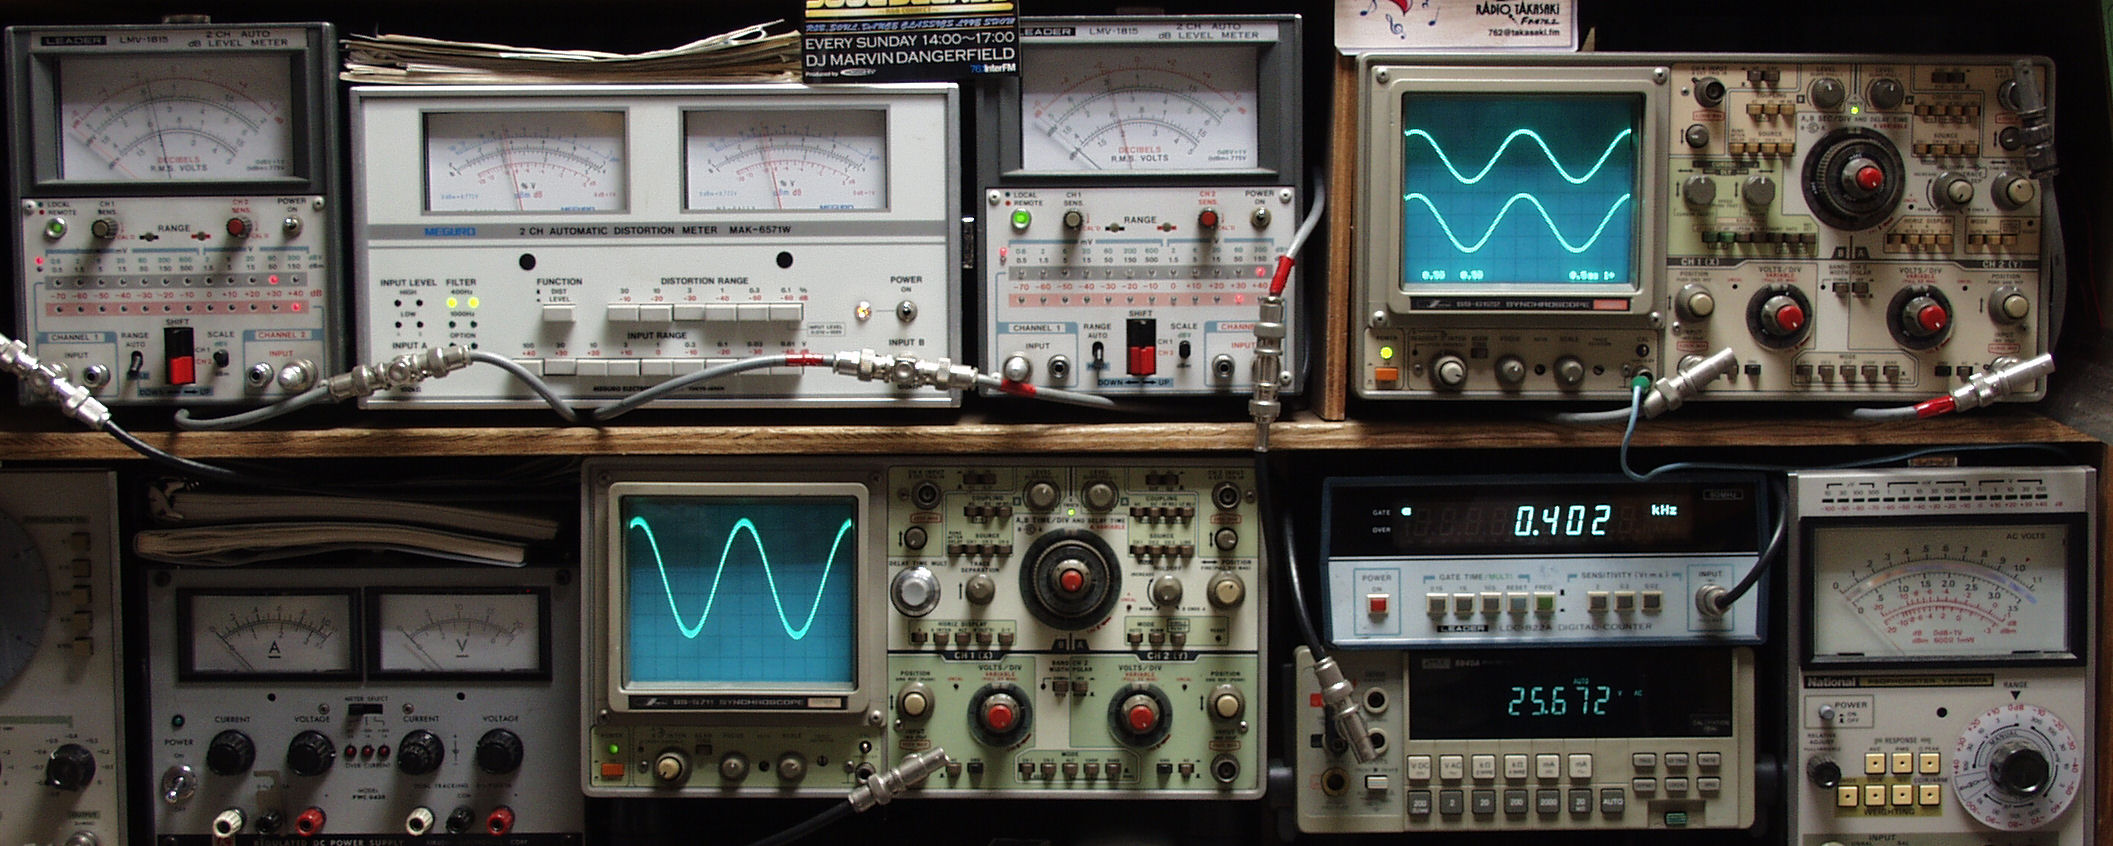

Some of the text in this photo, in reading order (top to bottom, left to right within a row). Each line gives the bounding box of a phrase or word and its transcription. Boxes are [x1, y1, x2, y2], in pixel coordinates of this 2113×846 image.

[1475, 1, 1560, 15] RADIO TAKASAKI
[241, 30, 270, 38] AUTO
[208, 39, 243, 47] LEVEL
[806, 37, 851, 50] EVERY
[856, 35, 918, 49] SUNDAY
[806, 47, 1016, 67] DJ MARVIN DANGERFIELD
[425, 228, 476, 236] MEGURO
[529, 227, 543, 235] CH
[550, 227, 607, 235] AUTOMATIC
[614, 226, 674, 235] DISTORTION
[682, 226, 717, 234] METER
[730, 225, 790, 234] MAK-6571W
[1681, 258, 1694, 266] CH
[661, 277, 749, 285] DISTORTION RANGE
[51, 333, 90, 341] CHANNEL
[1651, 504, 1678, 516] kHz
[1514, 505, 1611, 536] 0.402
[954, 651, 968, 660] CH
[1807, 677, 1856, 687] National
[1508, 686, 1611, 716] 25.672
[1990, 730, 2018, 746] MANUAL
